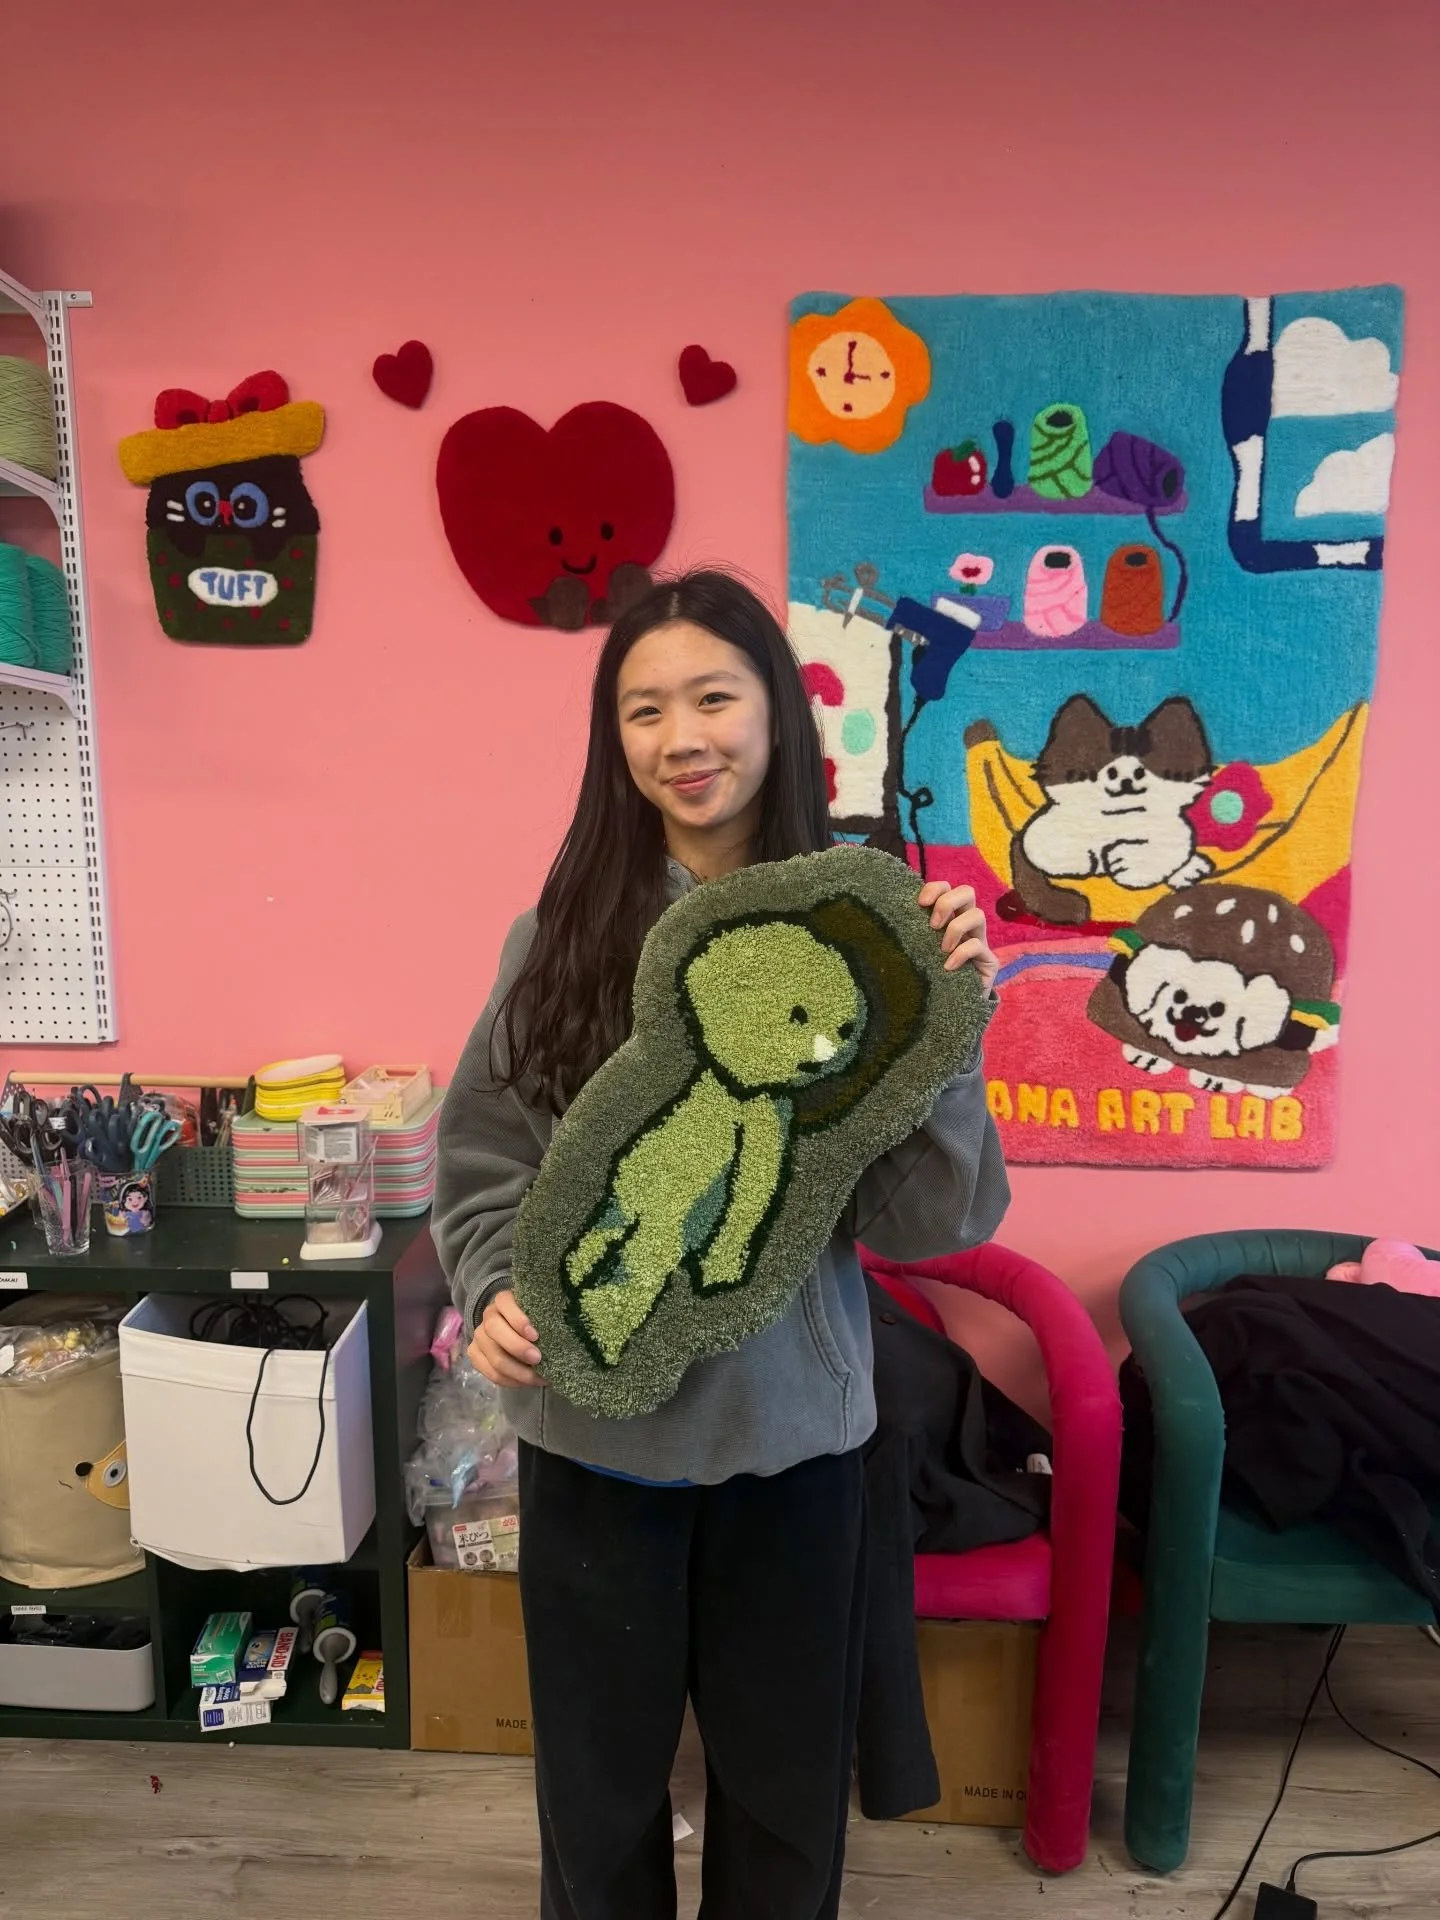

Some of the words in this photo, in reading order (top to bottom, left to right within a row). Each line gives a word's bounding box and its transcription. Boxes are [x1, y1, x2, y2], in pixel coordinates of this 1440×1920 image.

[200, 571, 268, 601] TUFT
[1098, 1088, 1195, 1135] ART
[1209, 1095, 1304, 1142] LAB
[271, 1632, 293, 1668] BAND-AID
[496, 1718, 527, 1730] MADE
[964, 1785, 999, 1799] MADE
[1002, 1787, 1014, 1800] IN
